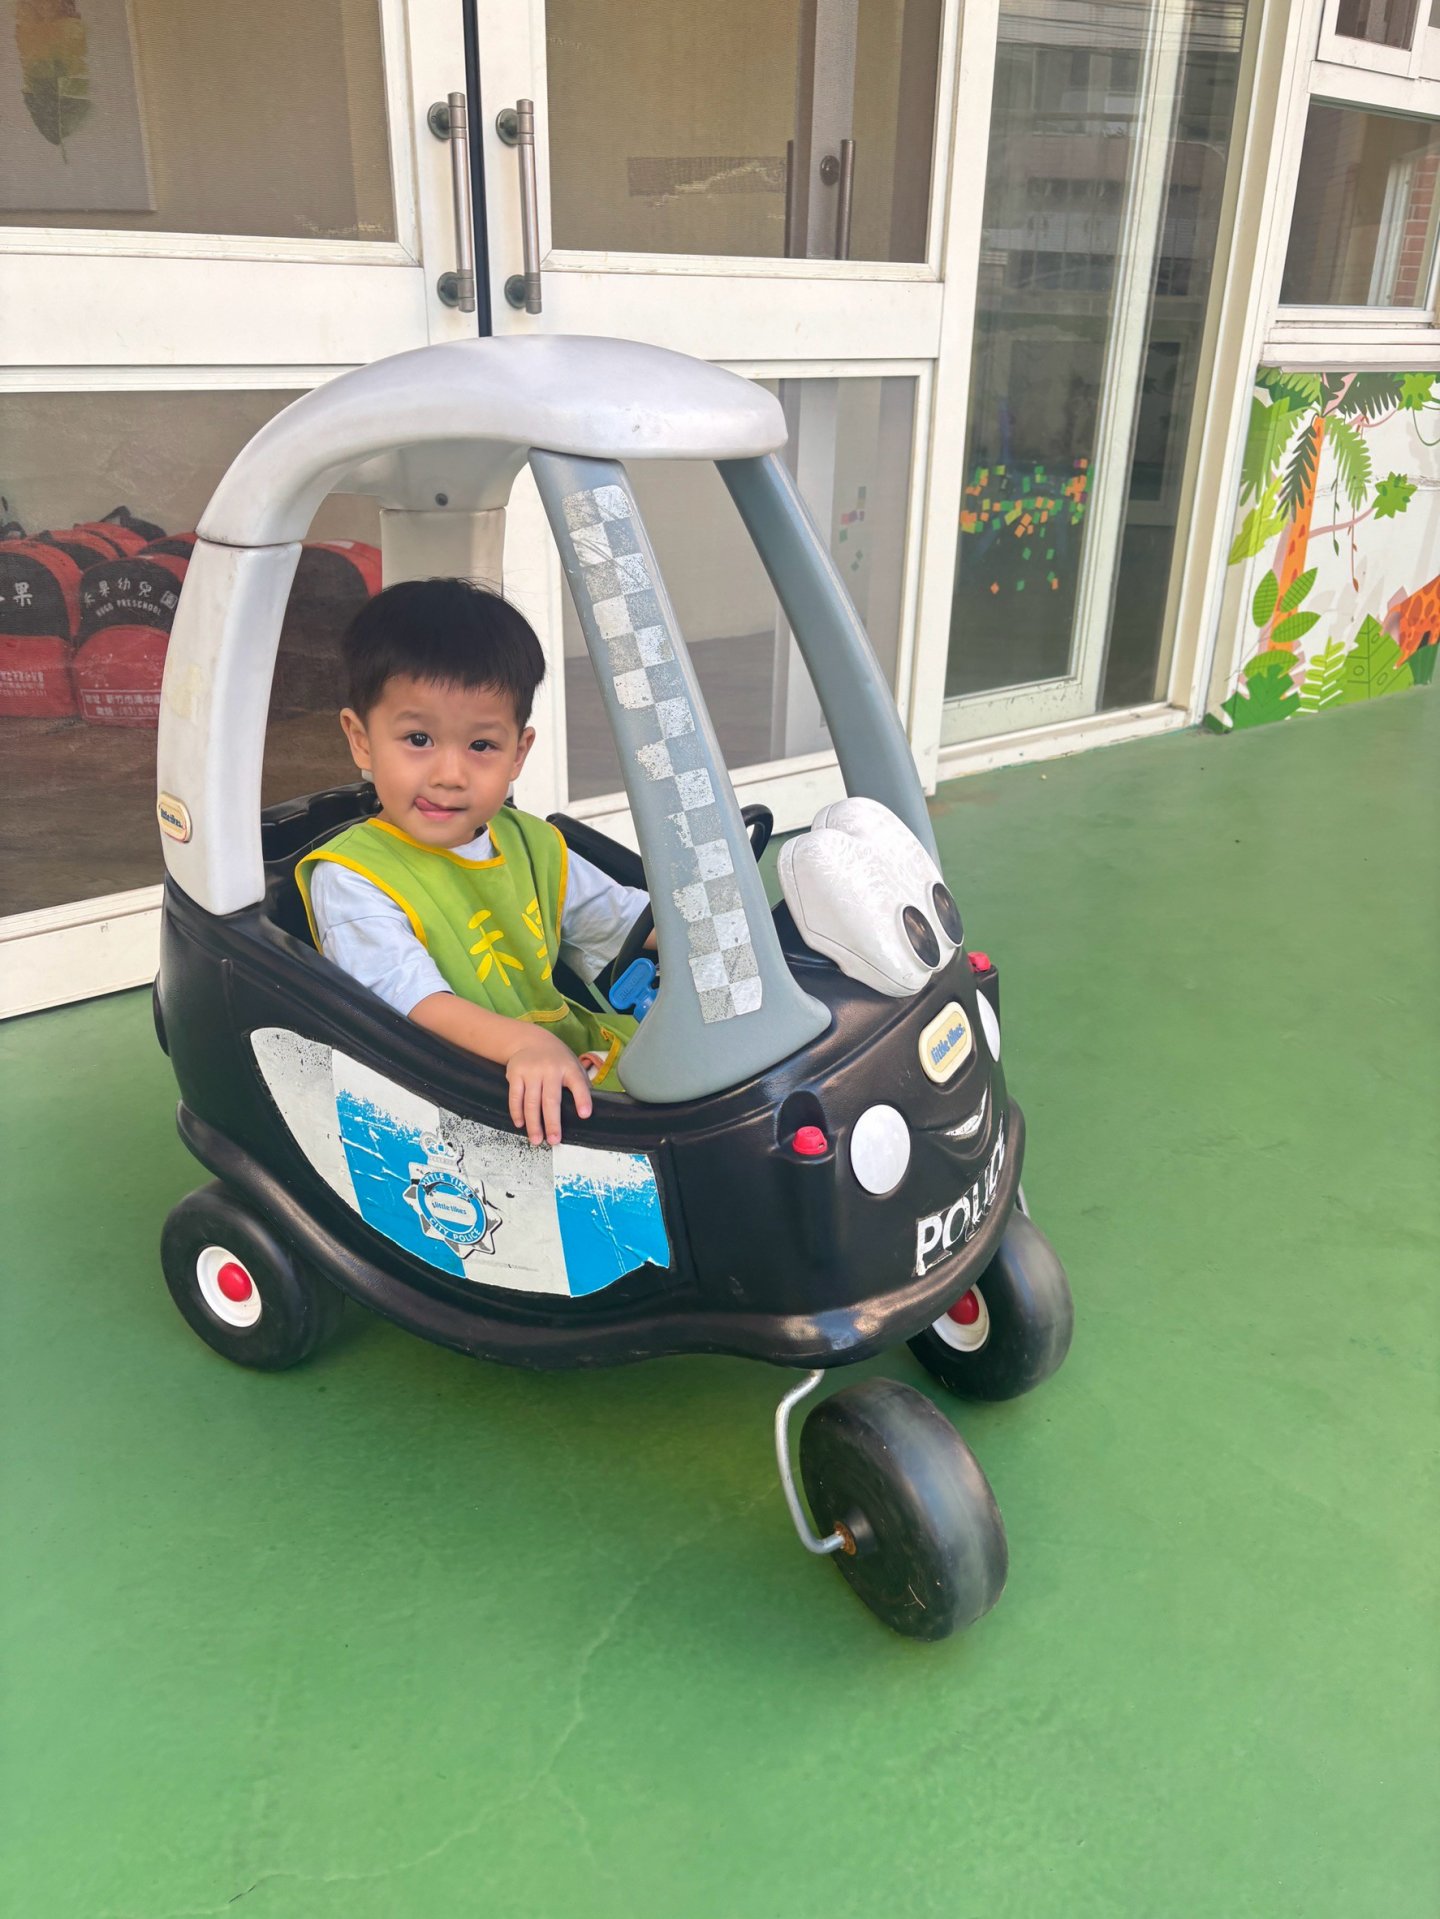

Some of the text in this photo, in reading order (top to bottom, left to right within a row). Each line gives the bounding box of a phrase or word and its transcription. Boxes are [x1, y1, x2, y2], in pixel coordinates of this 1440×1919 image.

[0, 582, 33, 607] 果
[116, 598, 161, 616] PRESCHOOL
[930, 1039, 951, 1065] little
[449, 1175, 474, 1197] TIKE
[429, 1217, 481, 1243] CITY POLICE
